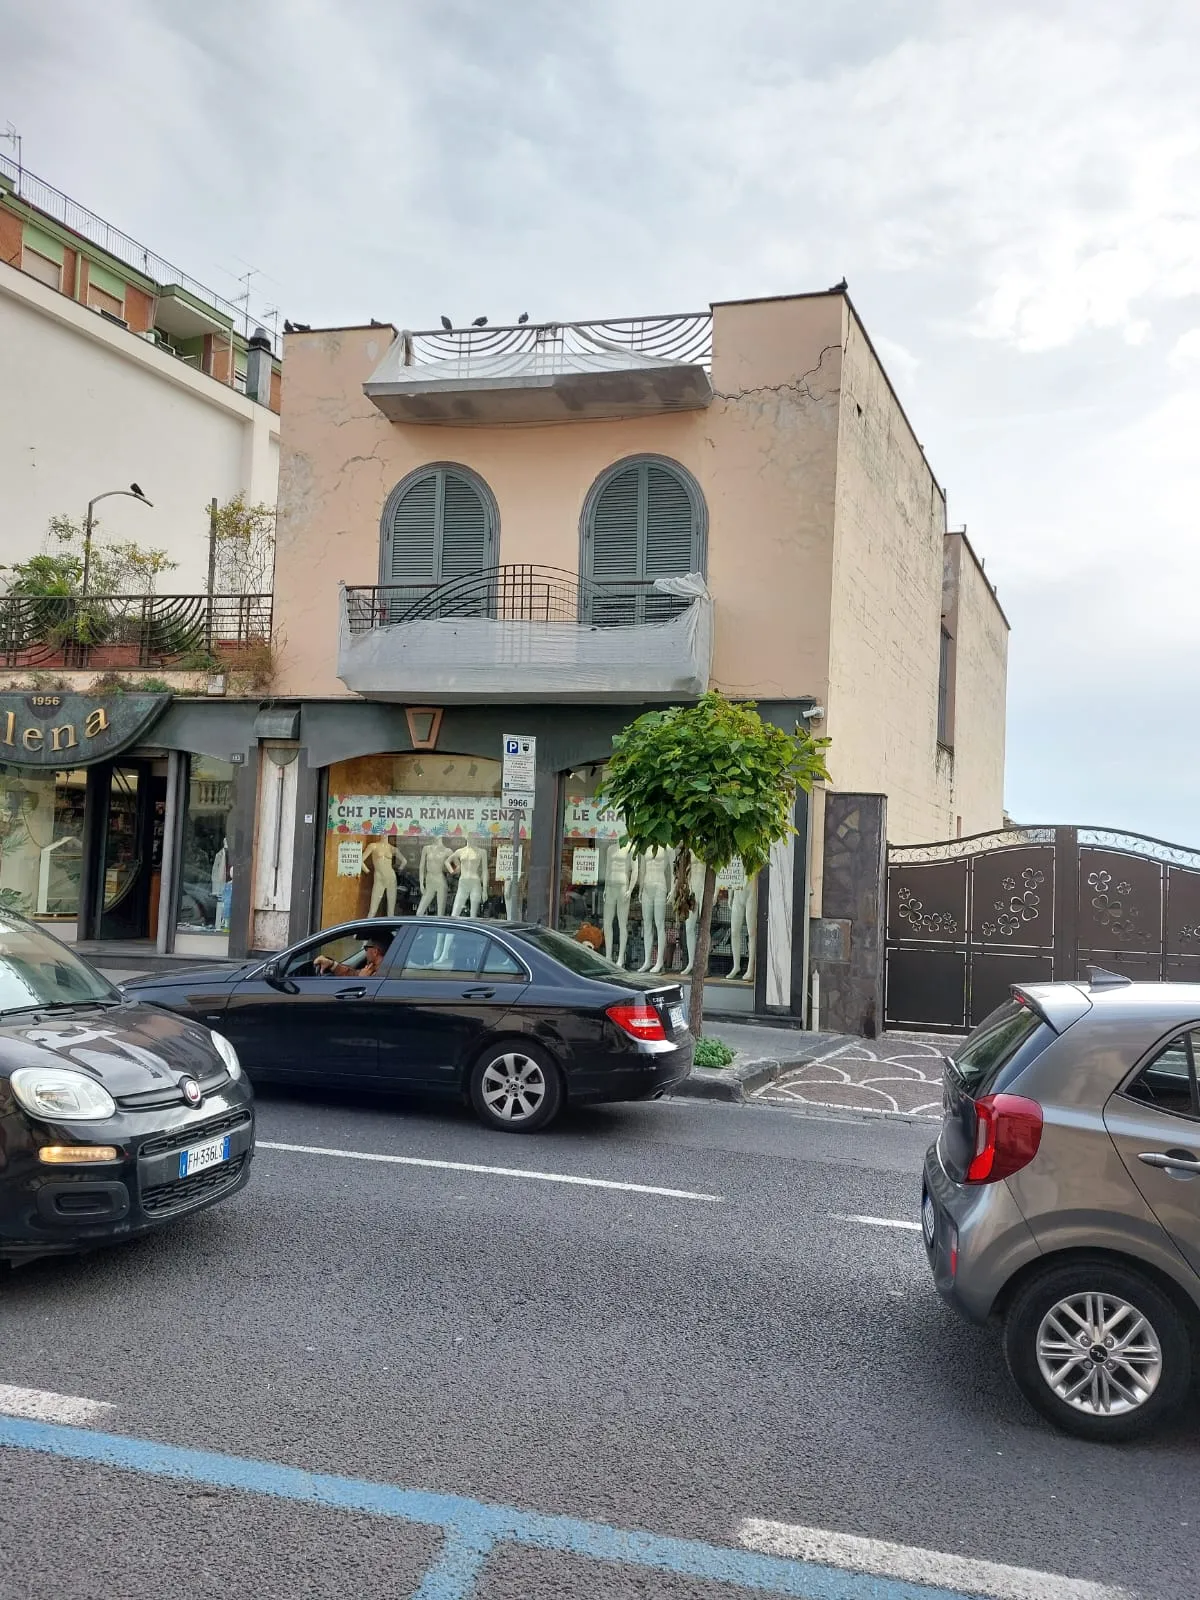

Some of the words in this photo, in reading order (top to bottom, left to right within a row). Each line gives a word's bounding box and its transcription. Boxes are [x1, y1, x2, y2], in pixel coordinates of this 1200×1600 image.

[32, 696, 60, 706] 1956
[2, 708, 111, 752] lena
[509, 741, 518, 753] P
[508, 798, 528, 807] 9966
[337, 805, 363, 818] CHI
[369, 806, 414, 819] PENSA
[419, 807, 475, 820] RIMANE
[480, 808, 527, 822] SENZA
[572, 809, 590, 821] LE
